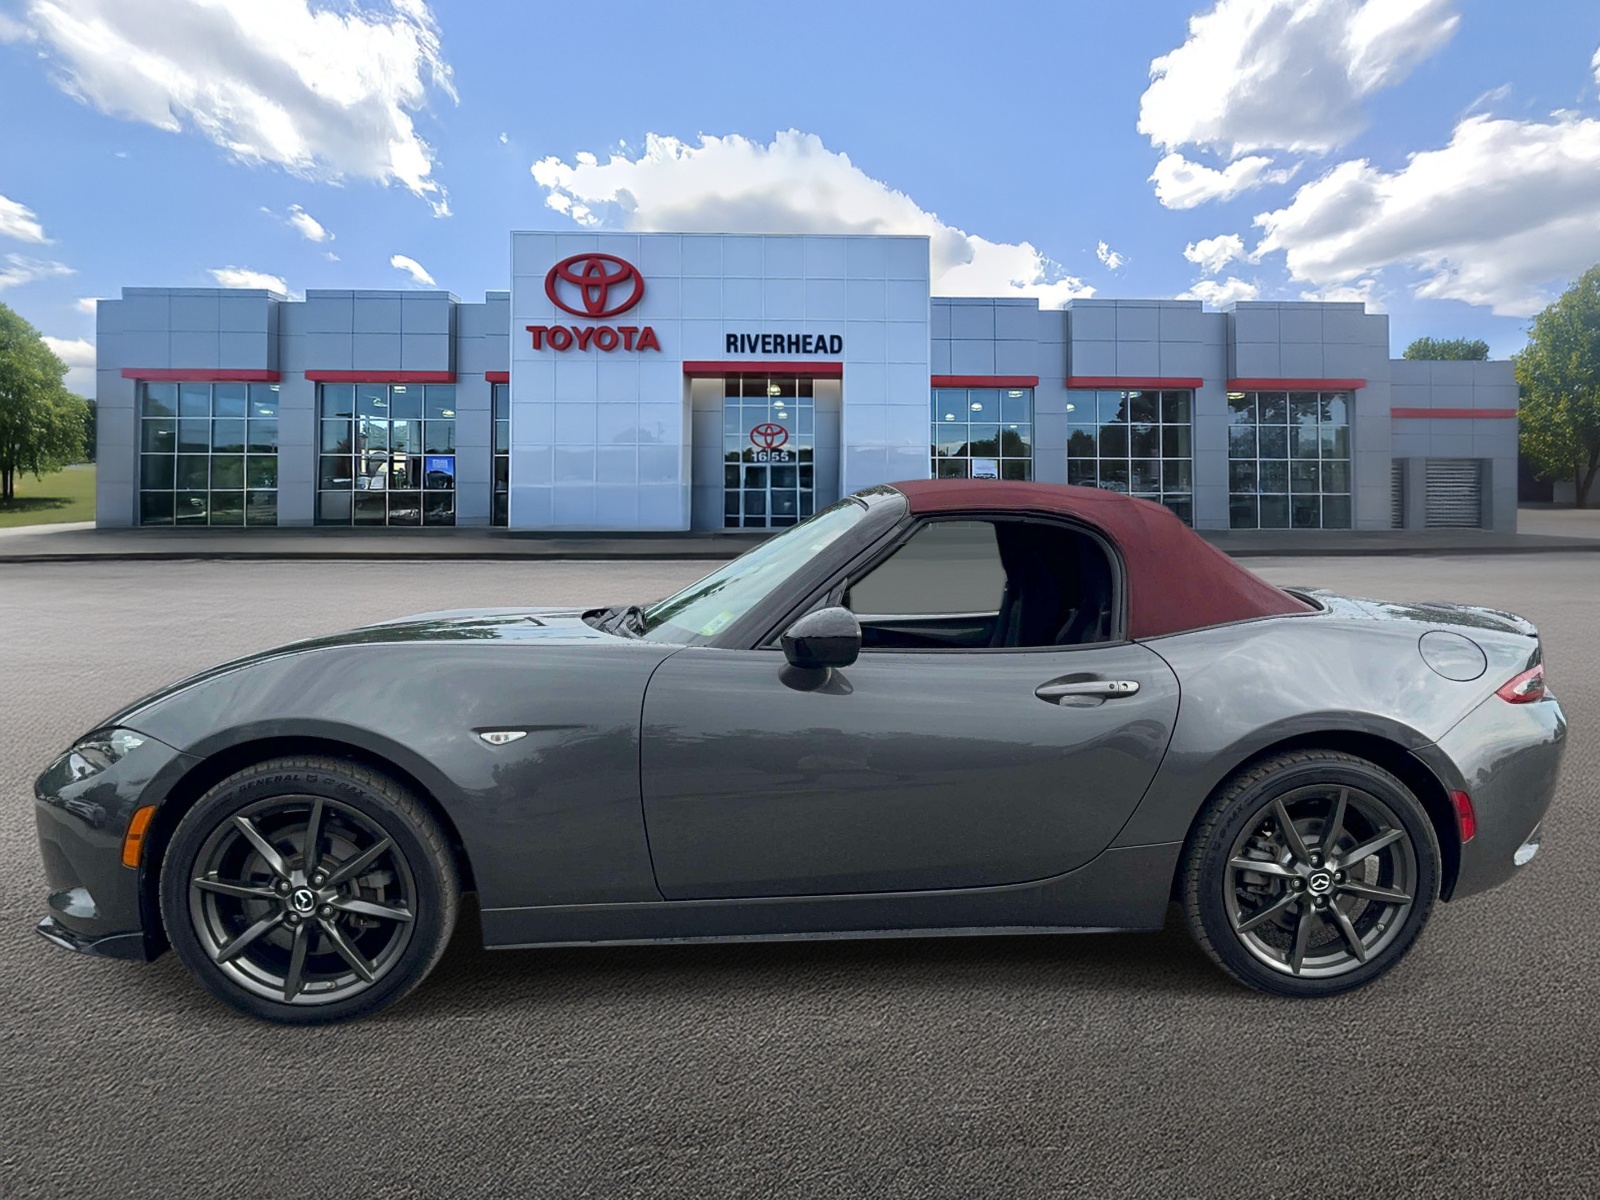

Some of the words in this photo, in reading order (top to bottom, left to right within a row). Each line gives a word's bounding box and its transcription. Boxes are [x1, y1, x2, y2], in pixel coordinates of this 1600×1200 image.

[526, 326, 661, 351] TOYOTA
[726, 333, 843, 354] RIVERHEAD
[752, 451, 789, 462] 1655
